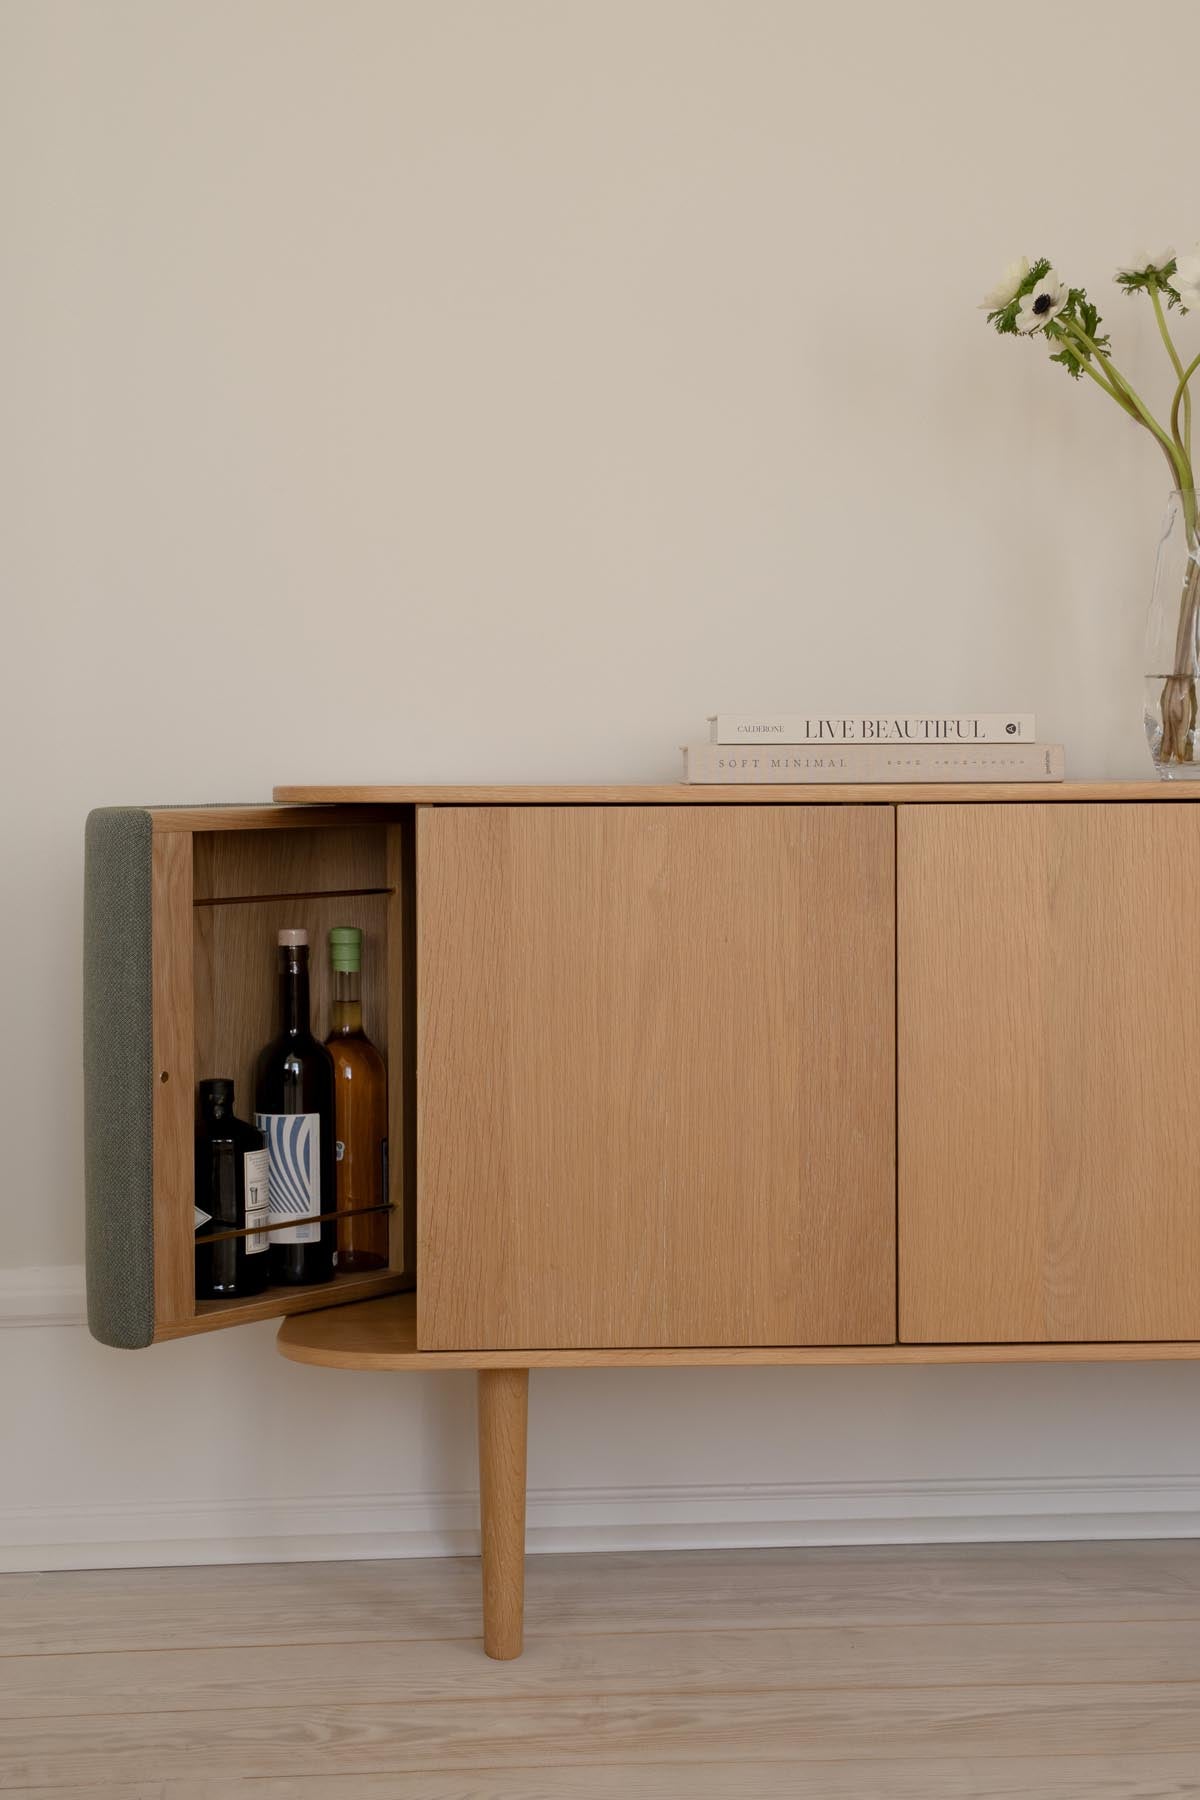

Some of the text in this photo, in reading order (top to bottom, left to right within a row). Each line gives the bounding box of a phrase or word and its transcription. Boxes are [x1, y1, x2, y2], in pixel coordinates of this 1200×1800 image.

[737, 725, 785, 733] CALDERONE
[805, 720, 986, 738] LIVE BEAUTIFUL
[718, 759, 847, 768] SOFT MINIMAL
